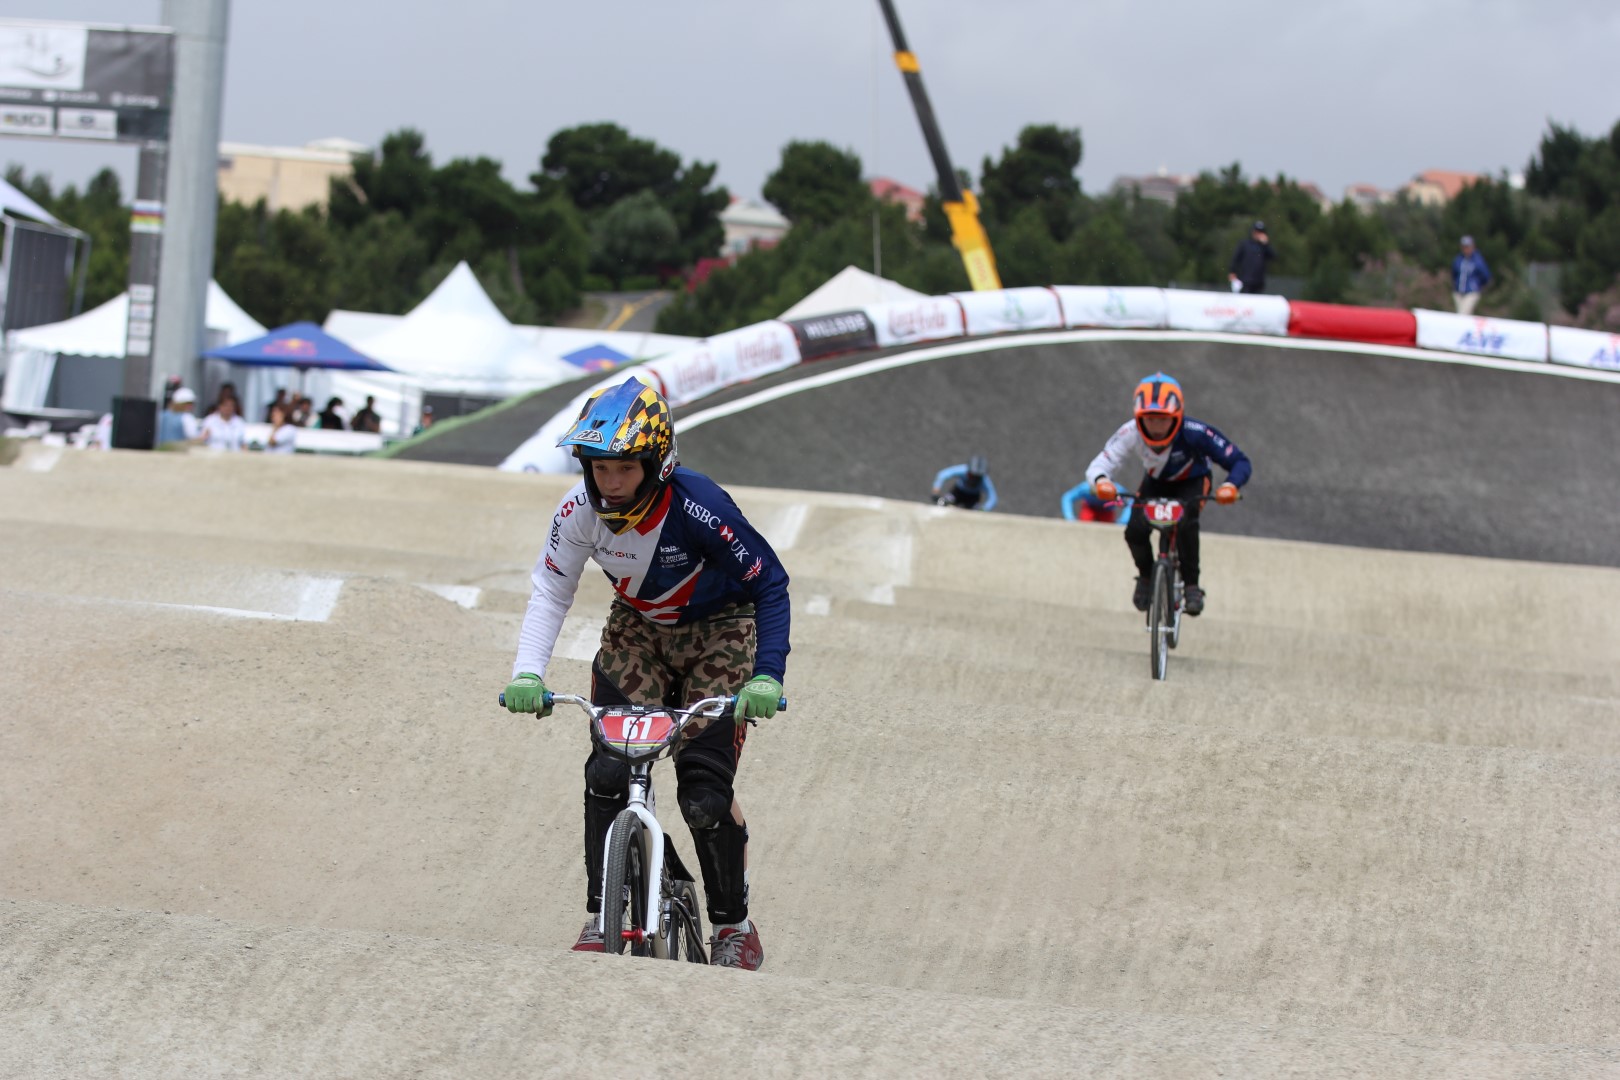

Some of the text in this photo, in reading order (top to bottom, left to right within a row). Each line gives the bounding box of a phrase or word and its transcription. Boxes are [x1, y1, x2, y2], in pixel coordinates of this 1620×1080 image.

[683, 497, 750, 564] HSBC UK
[625, 552, 638, 560] UK
[622, 717, 653, 740] 67
